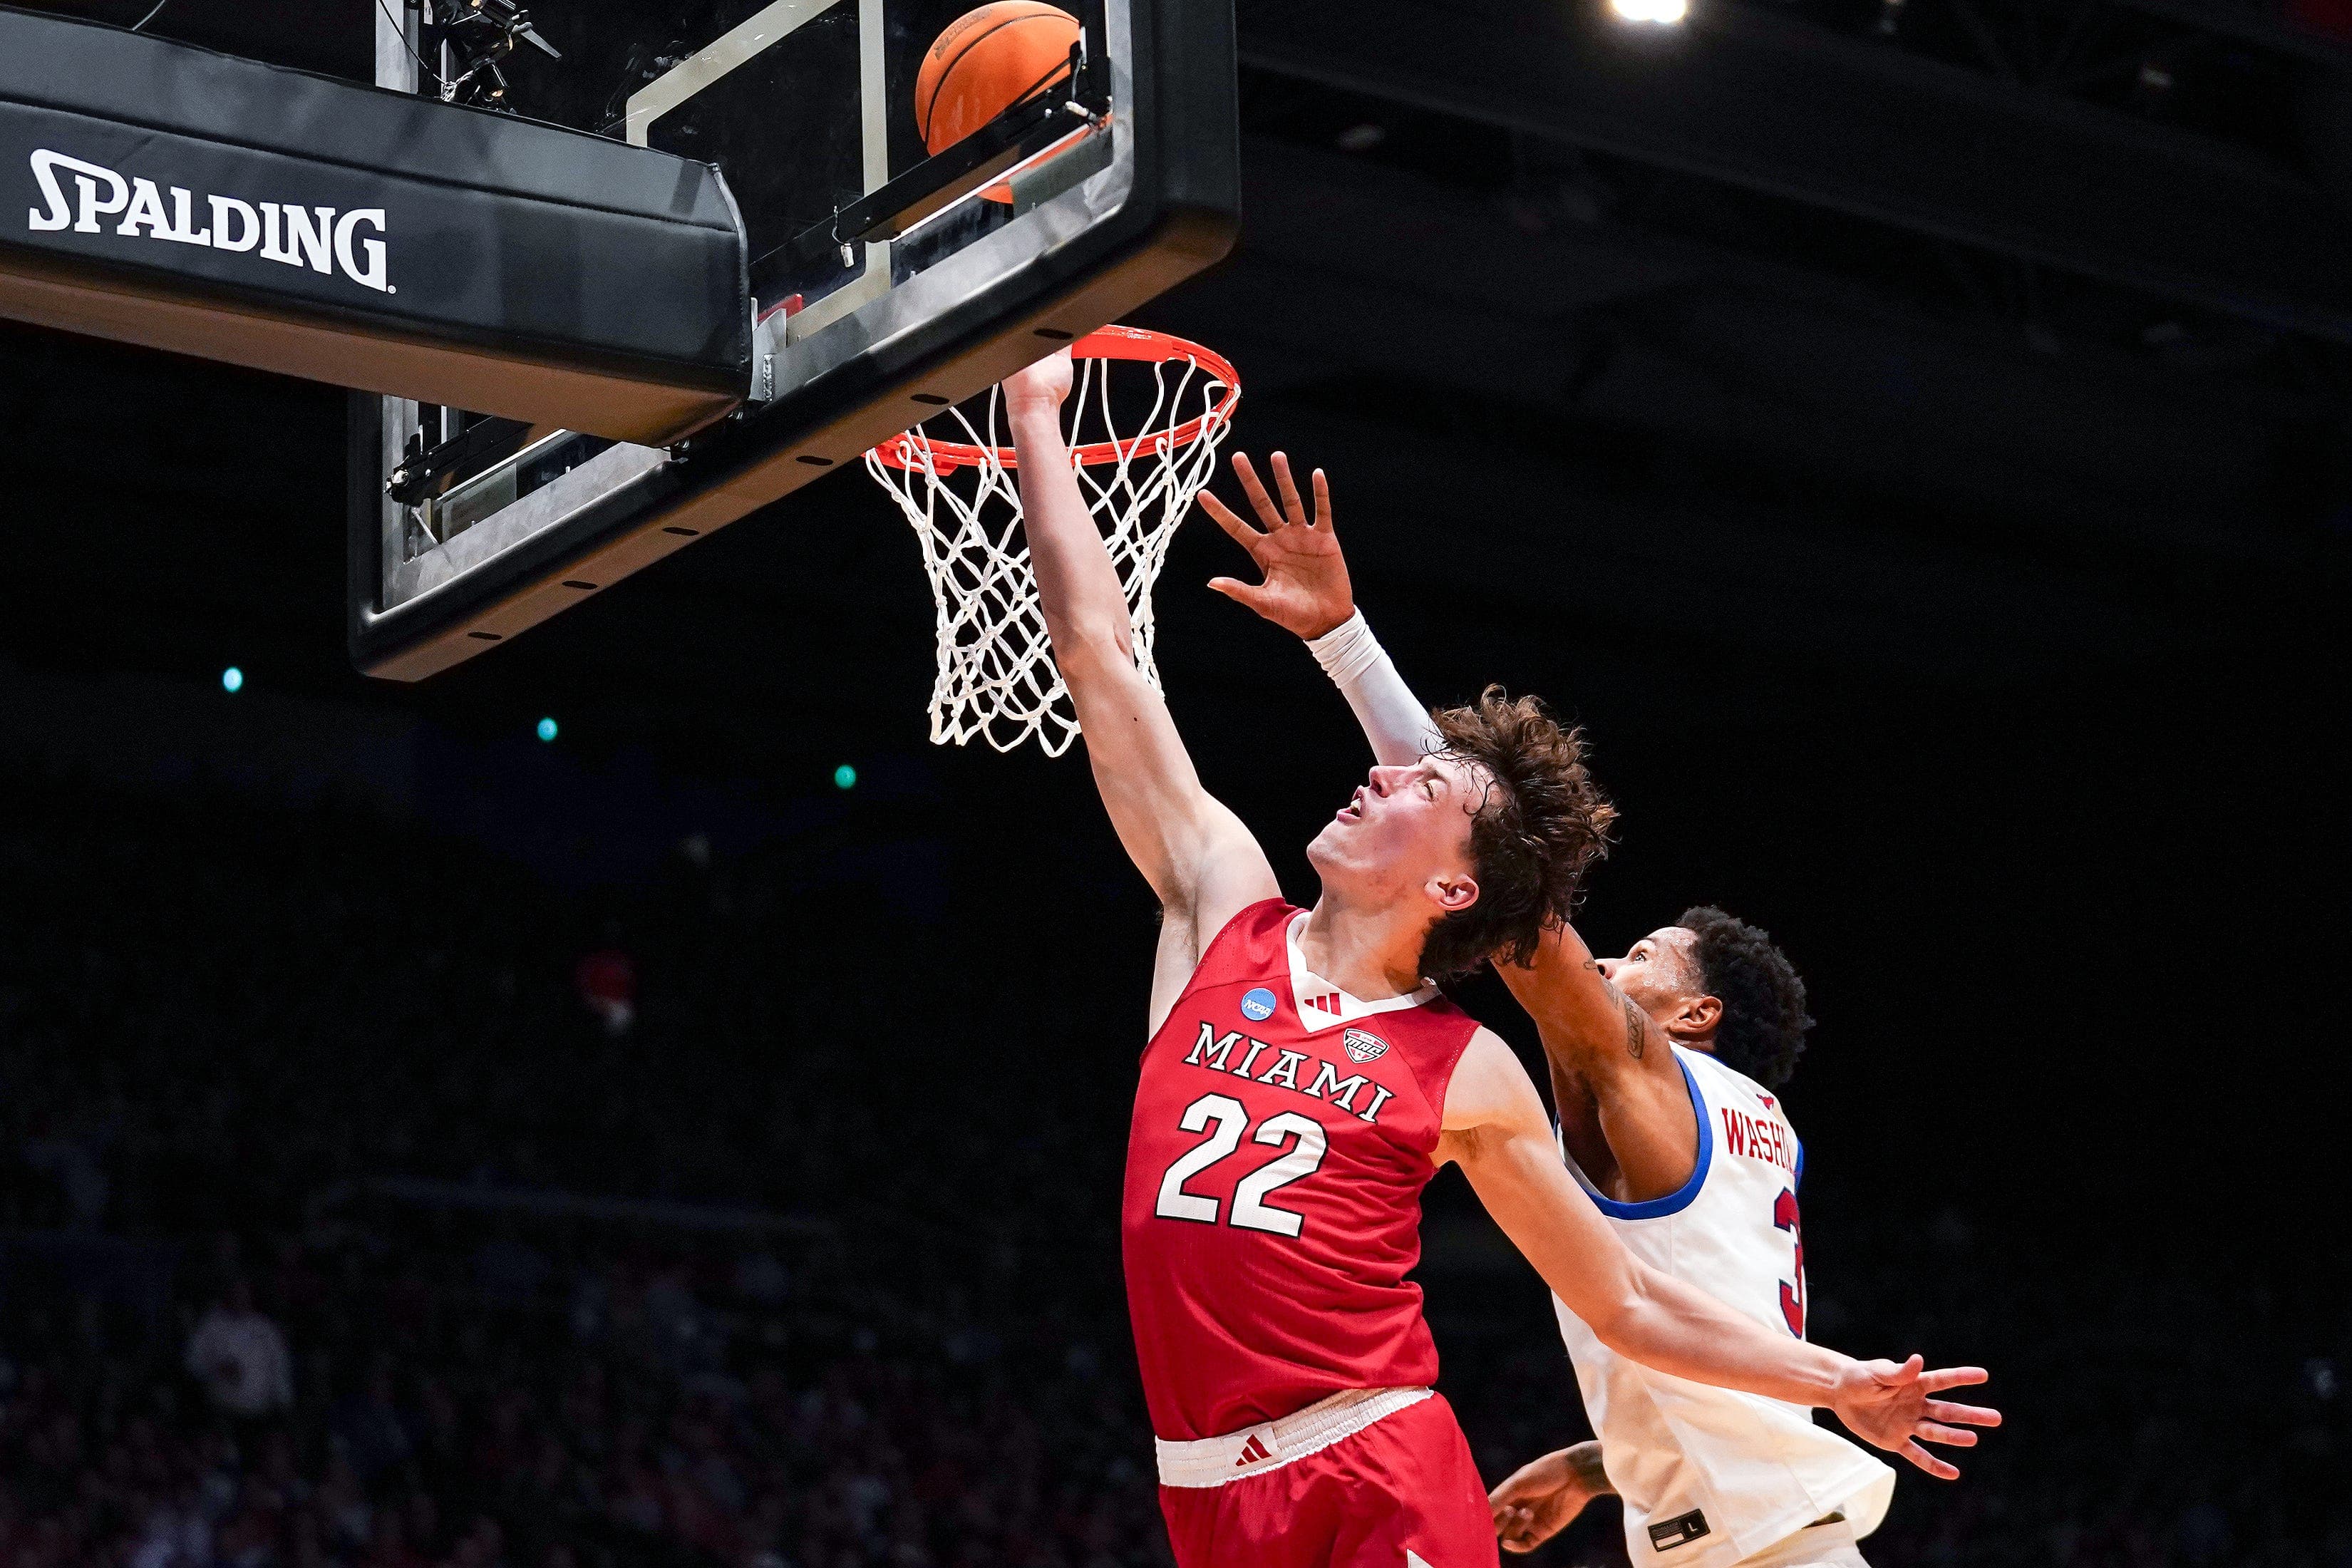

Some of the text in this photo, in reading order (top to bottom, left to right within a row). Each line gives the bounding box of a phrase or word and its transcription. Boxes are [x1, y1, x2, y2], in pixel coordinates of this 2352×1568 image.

[29, 148, 386, 292] SPALDING
[1243, 999, 1272, 1016] NCAA
[1344, 1036, 1383, 1057] MAC
[1182, 1020, 1396, 1124] MIAMI
[1155, 1092, 1329, 1239] 22
[1773, 1185, 1805, 1340] 3
